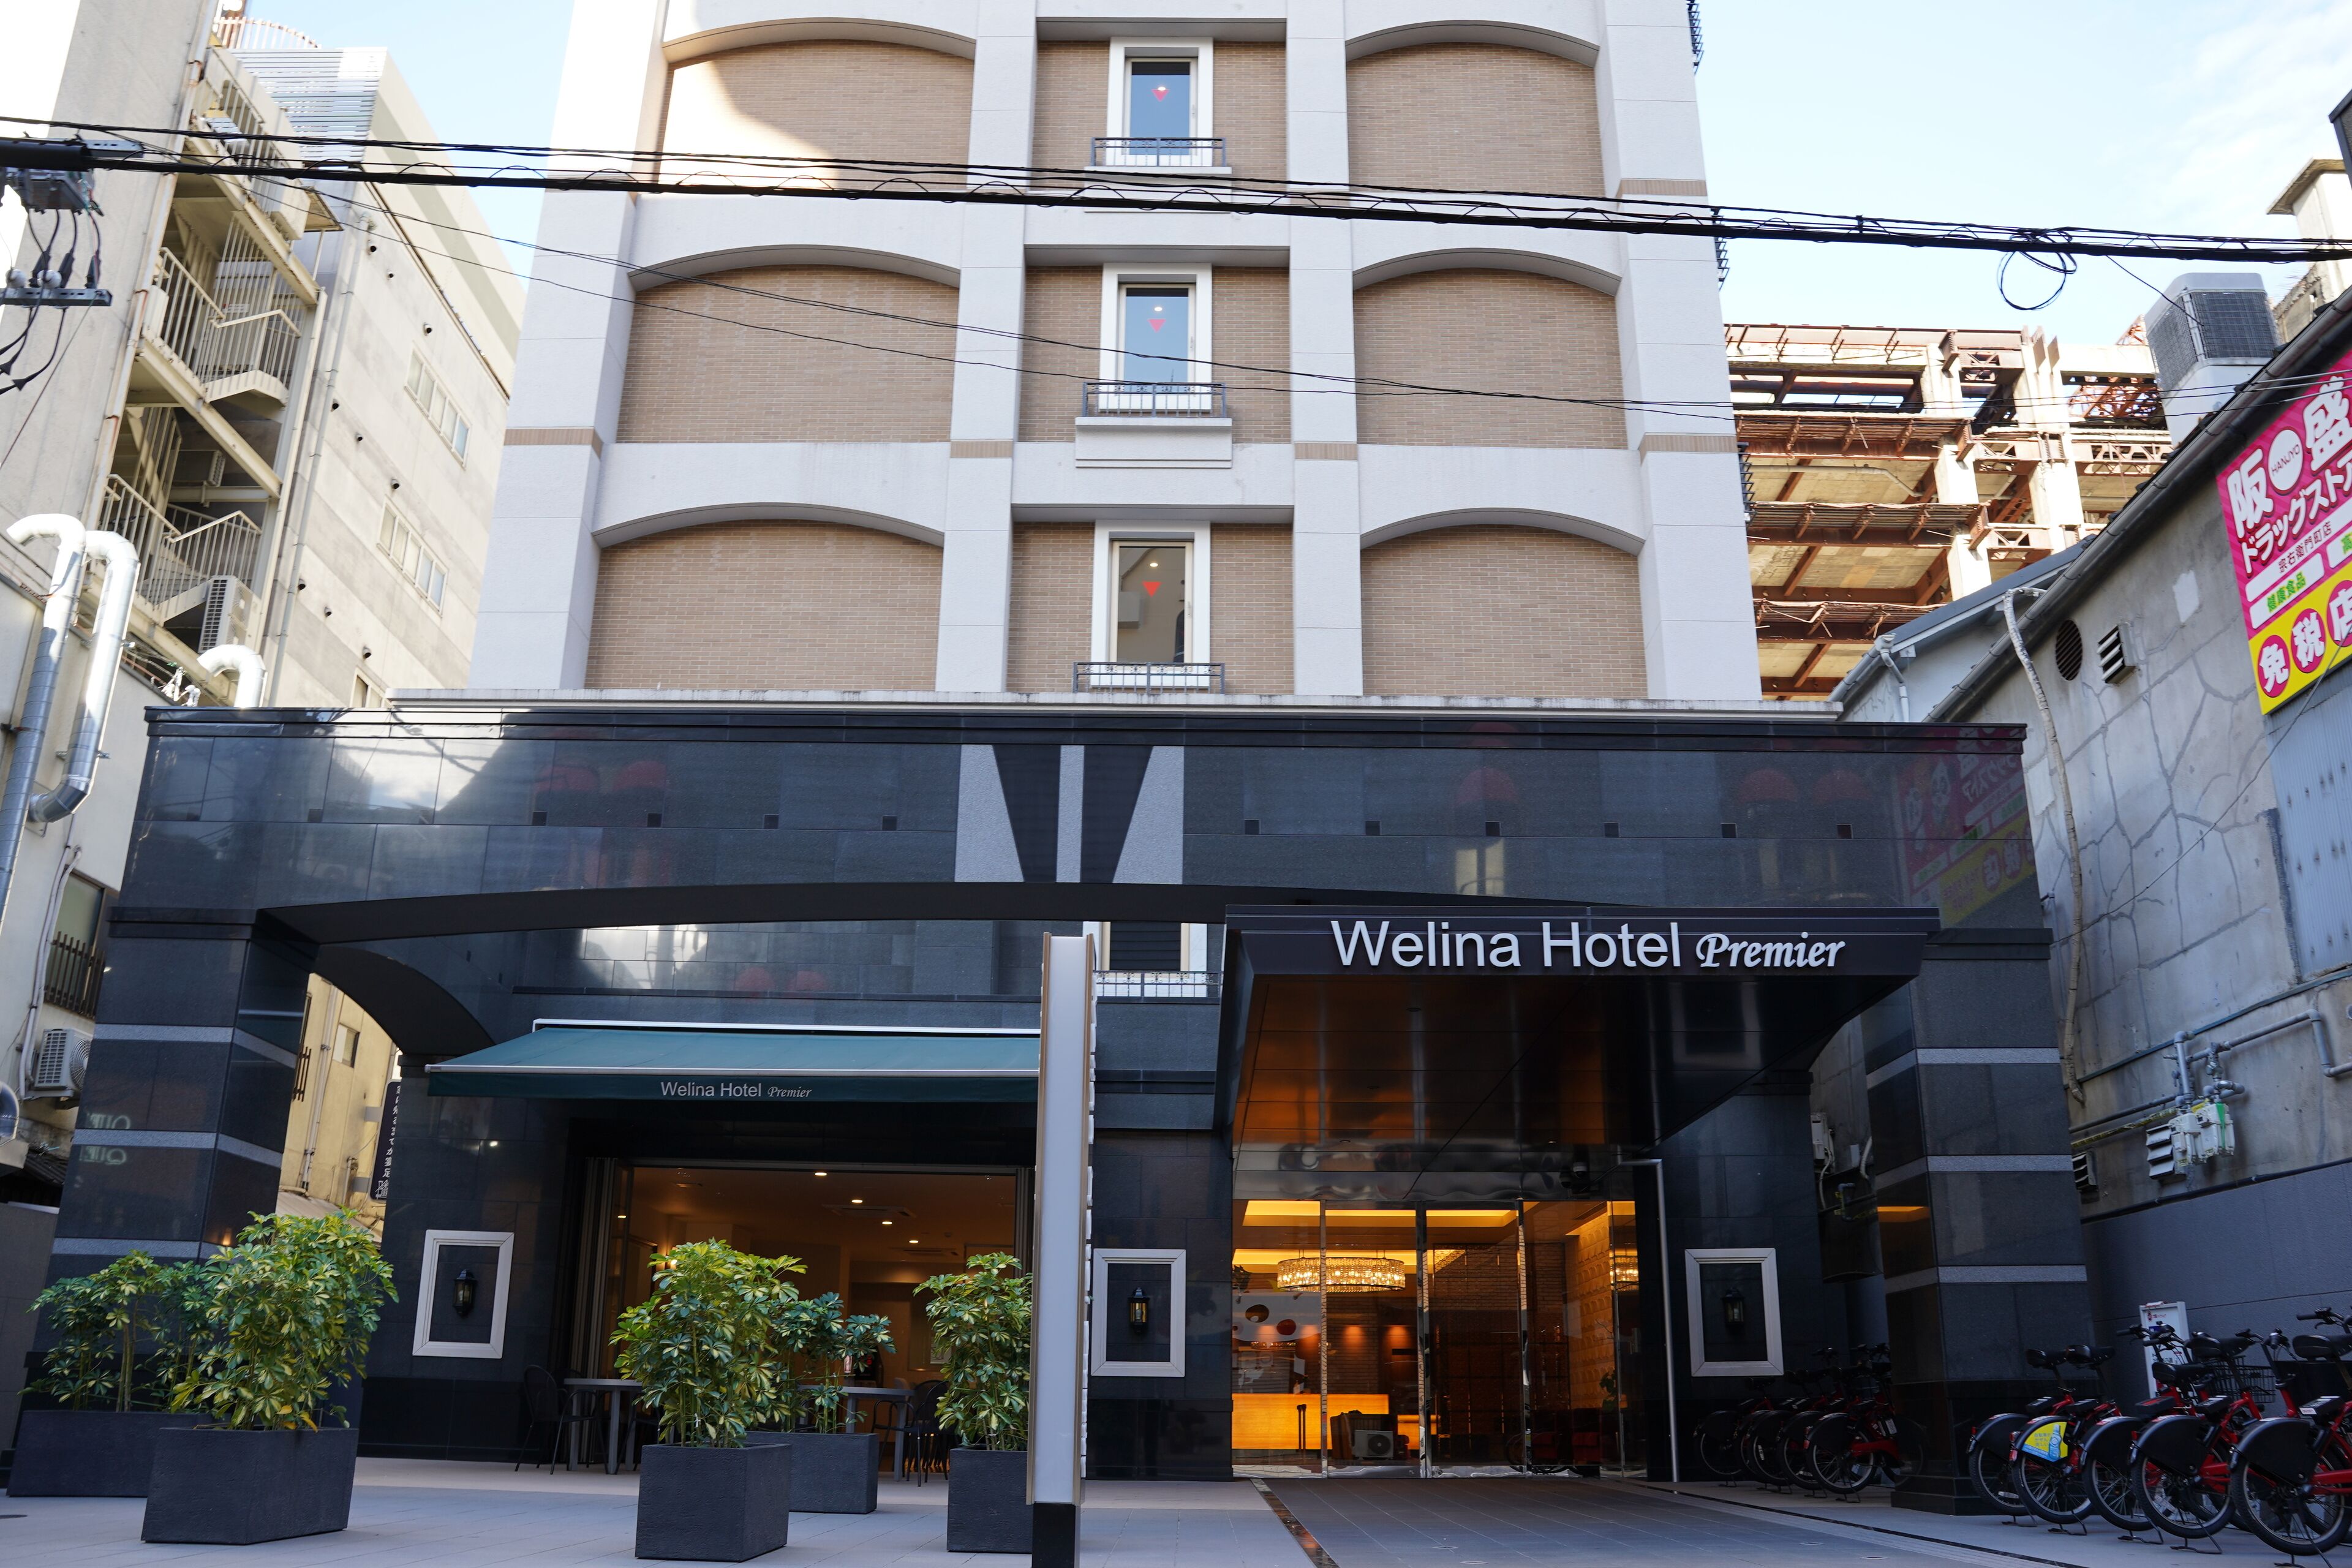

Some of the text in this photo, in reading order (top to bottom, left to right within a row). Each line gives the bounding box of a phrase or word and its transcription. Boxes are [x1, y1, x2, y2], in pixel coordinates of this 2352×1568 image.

[2227, 448, 2274, 539] 阪
[2303, 376, 2352, 471] 盛
[1330, 920, 1845, 968] Welina Hotel Premier
[660, 1082, 812, 1098] Welina Hotel Premier
